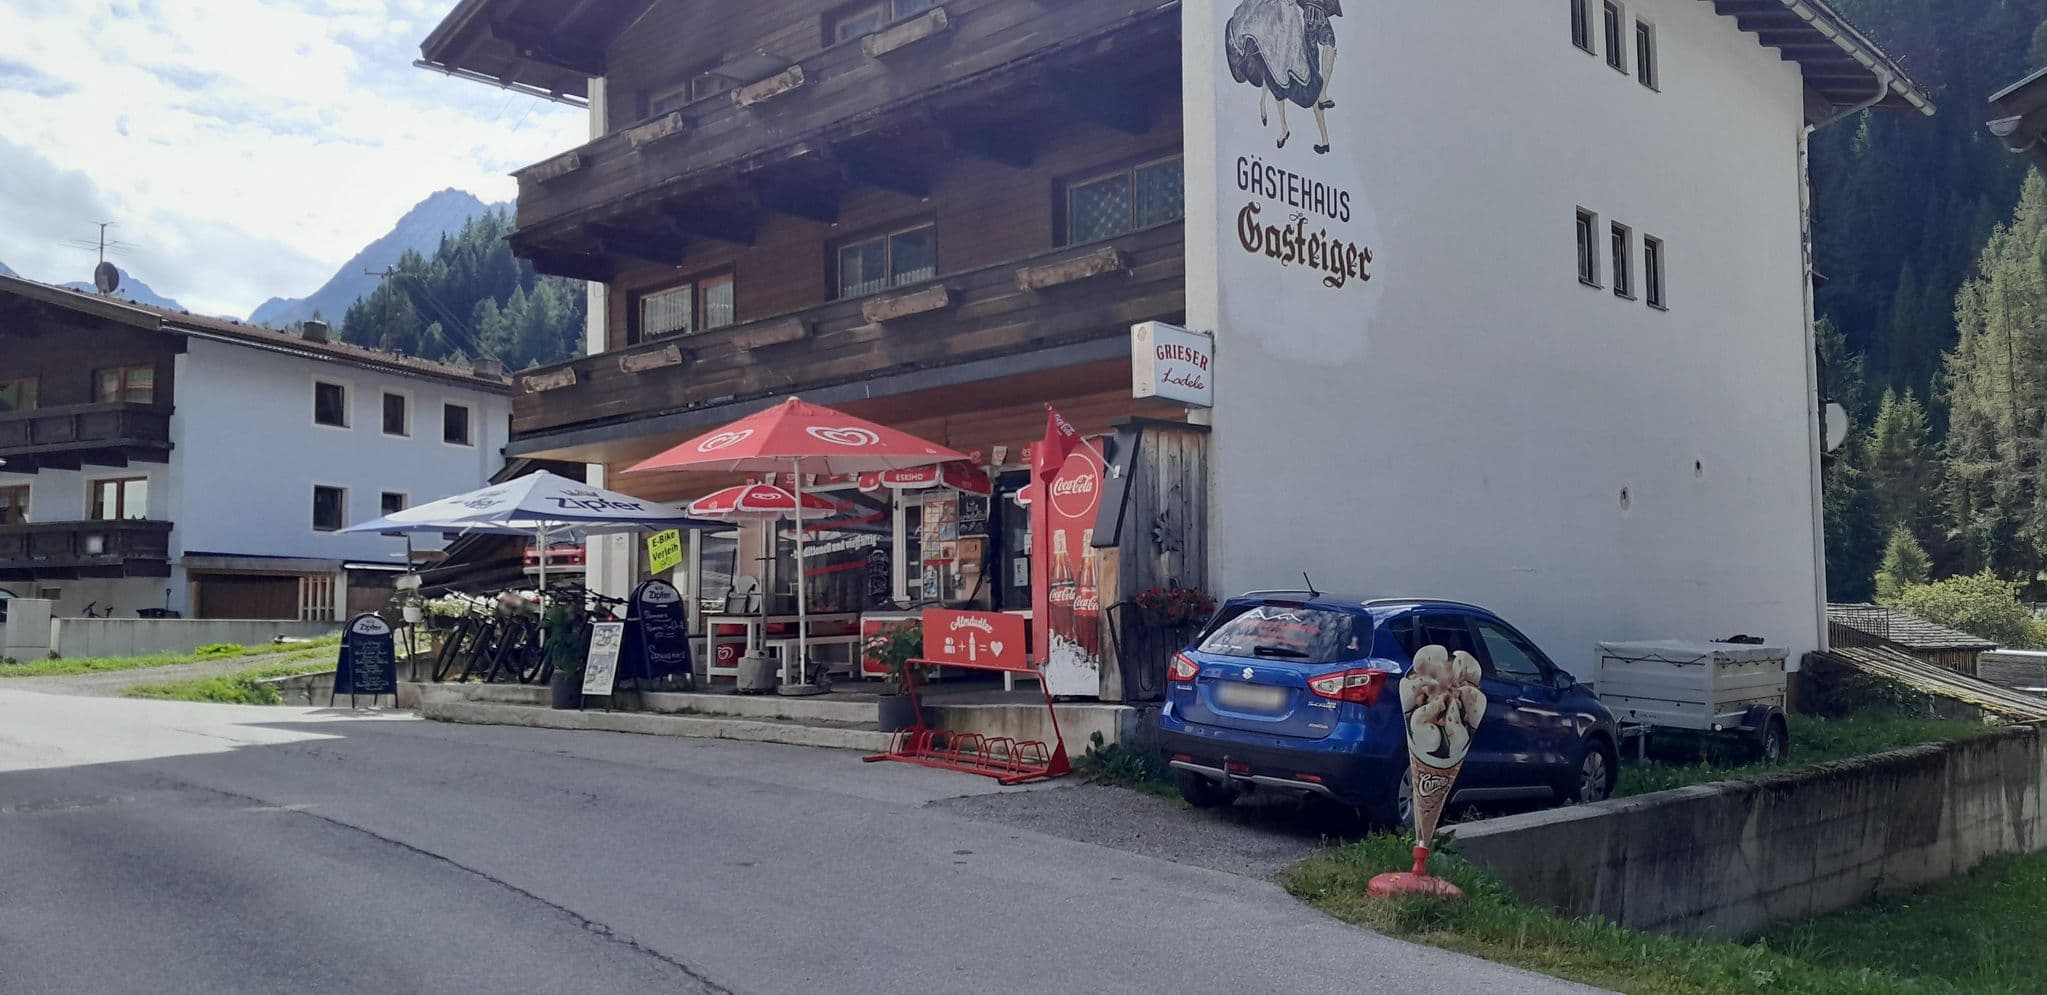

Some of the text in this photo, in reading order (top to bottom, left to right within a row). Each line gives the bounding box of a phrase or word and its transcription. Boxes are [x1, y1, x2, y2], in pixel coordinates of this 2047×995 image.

[1236, 154, 1351, 222] GÄSTEHAUS
[1237, 201, 1373, 289] Gasteiger
[1156, 343, 1209, 372] GRIESER
[1161, 367, 1205, 391] Ladele
[895, 473, 924, 482] ESKIMO
[1053, 473, 1095, 497] Coca-Cola
[545, 496, 646, 513] Zipfer
[652, 531, 676, 547] E-Bike
[653, 543, 679, 561] Verleih
[649, 590, 672, 600] Zipfer
[1049, 586, 1076, 602] Coca-Cola
[360, 623, 382, 632] Zipfer
